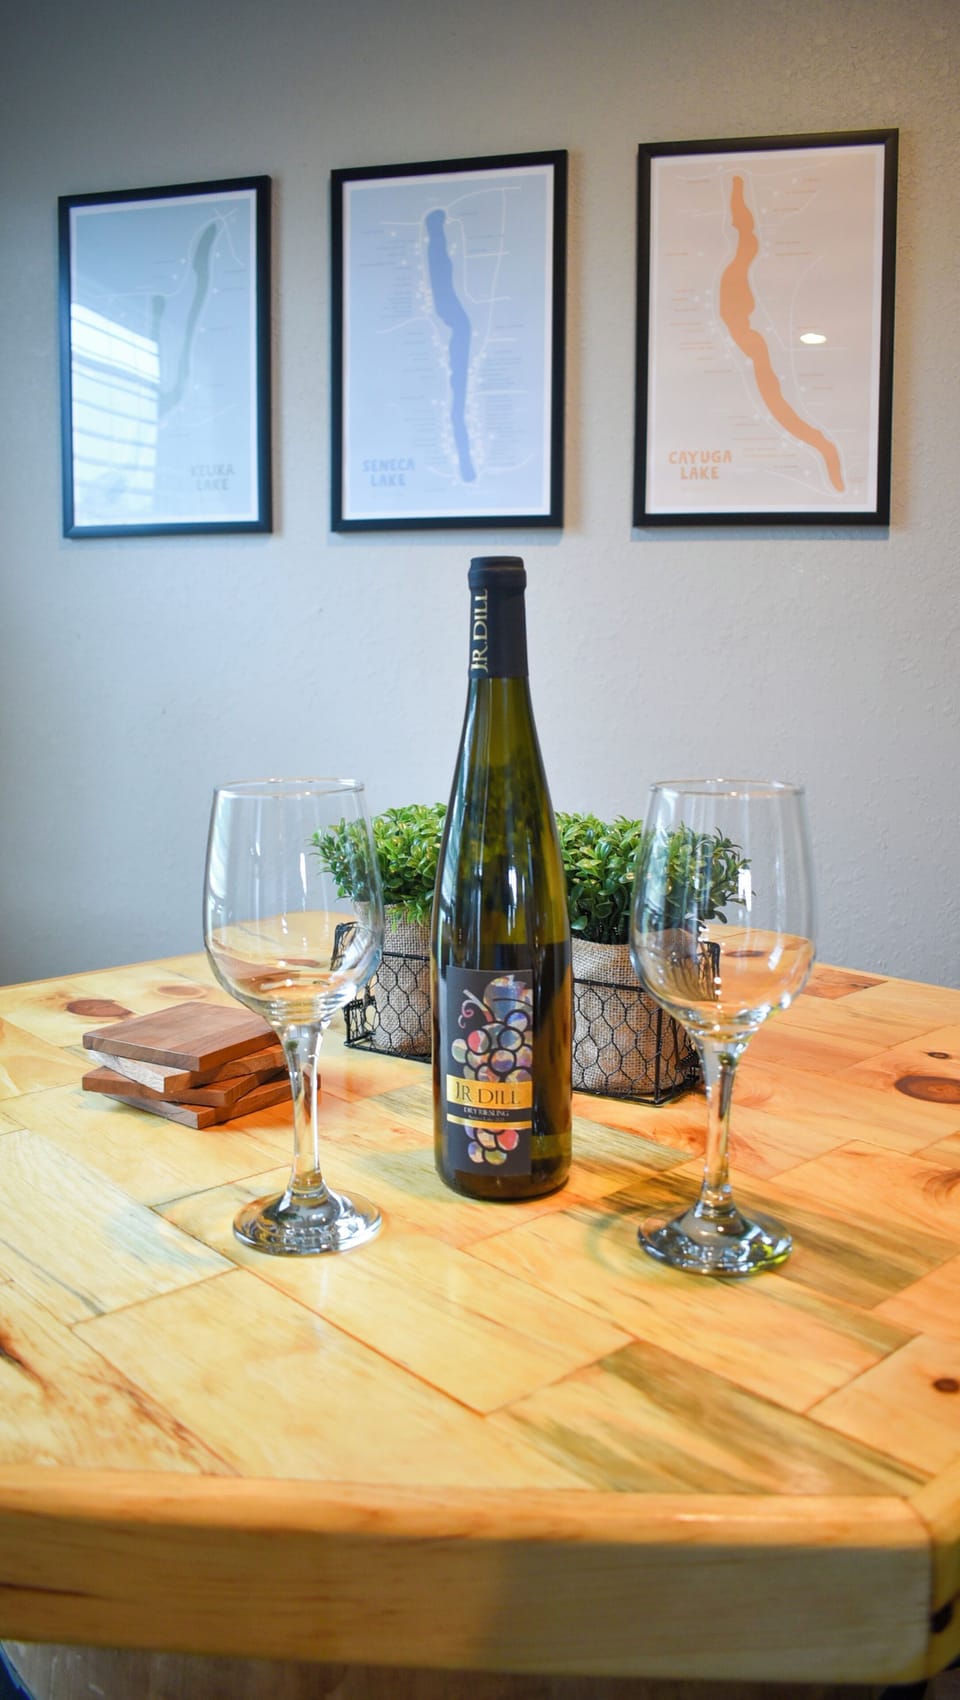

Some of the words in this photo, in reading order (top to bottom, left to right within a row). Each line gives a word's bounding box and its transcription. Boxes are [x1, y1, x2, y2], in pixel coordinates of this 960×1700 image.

[668, 449, 732, 464] CAYUGA
[361, 457, 415, 472] SENECA
[370, 472, 406, 487] LAKE
[680, 466, 720, 480] LAKE
[472, 588, 488, 640] DILL
[477, 1088, 521, 1104] DILL
